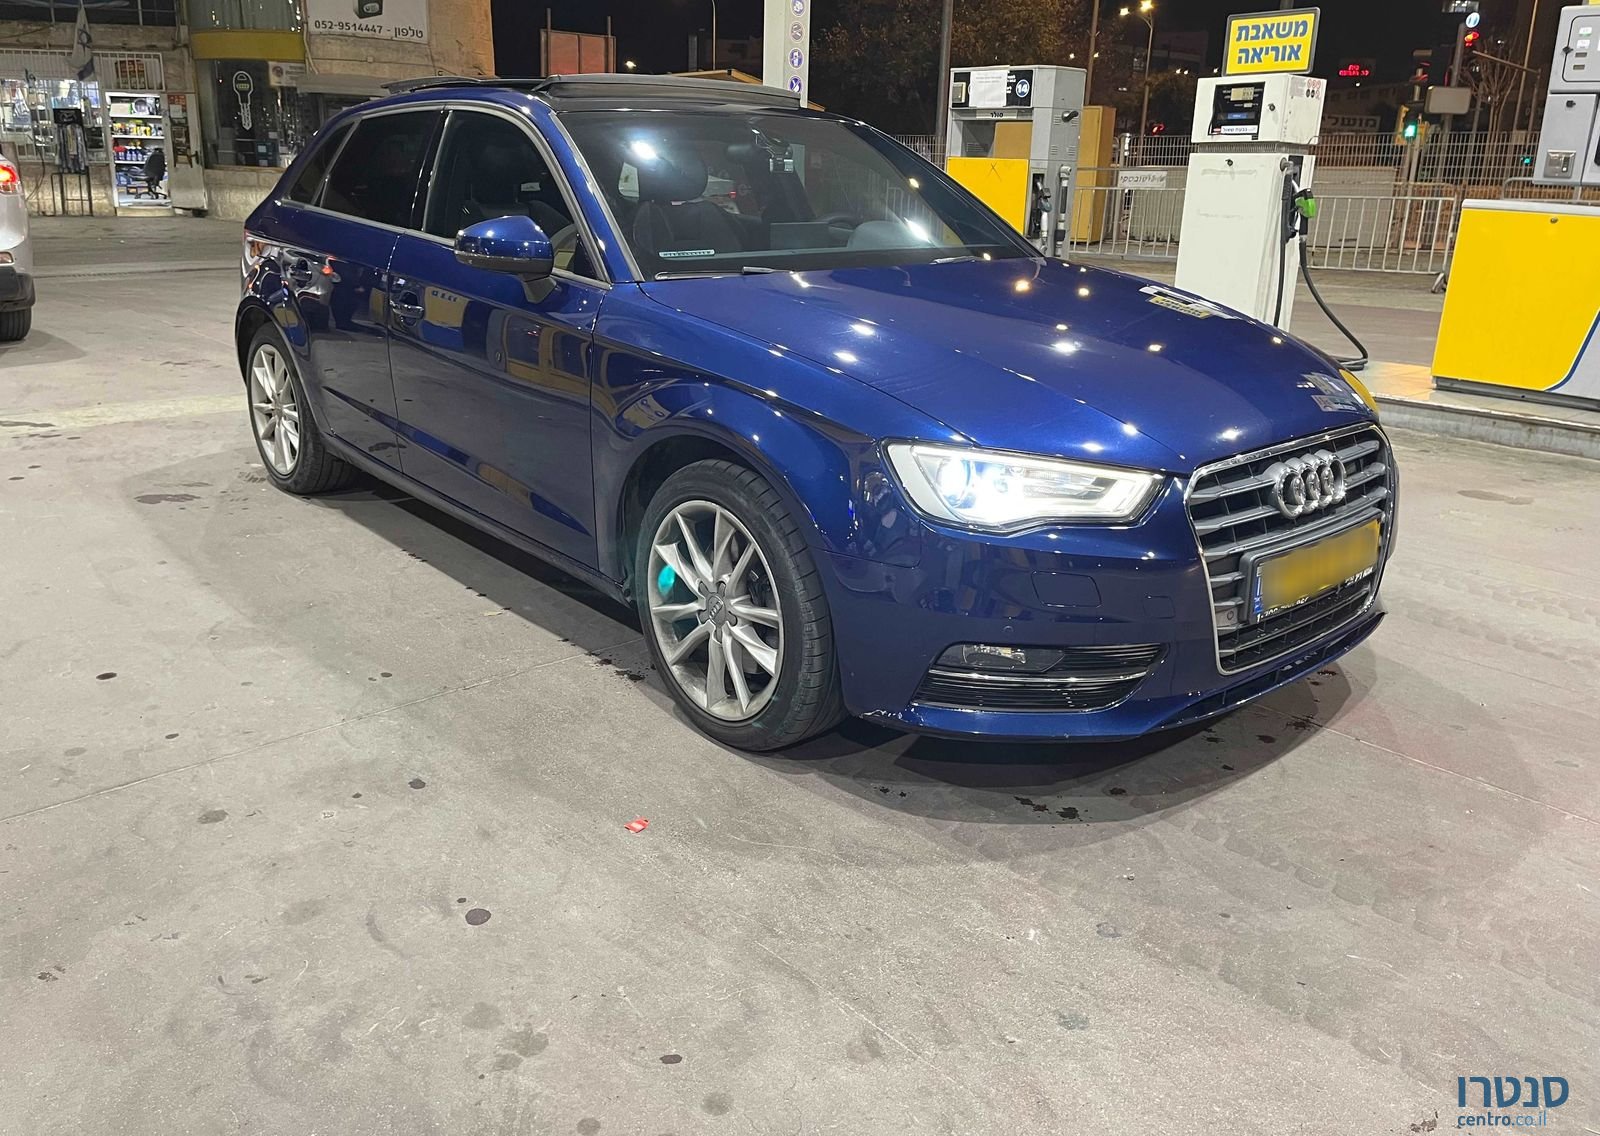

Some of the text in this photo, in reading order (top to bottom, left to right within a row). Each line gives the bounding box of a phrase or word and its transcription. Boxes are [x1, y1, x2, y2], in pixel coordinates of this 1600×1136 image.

[314, 20, 383, 34] 052-9514447
[394, 26, 424, 38] טלפון
[1236, 20, 1308, 42] משאבת
[1237, 44, 1302, 64] אוריאה
[1017, 84, 1028, 93] 14
